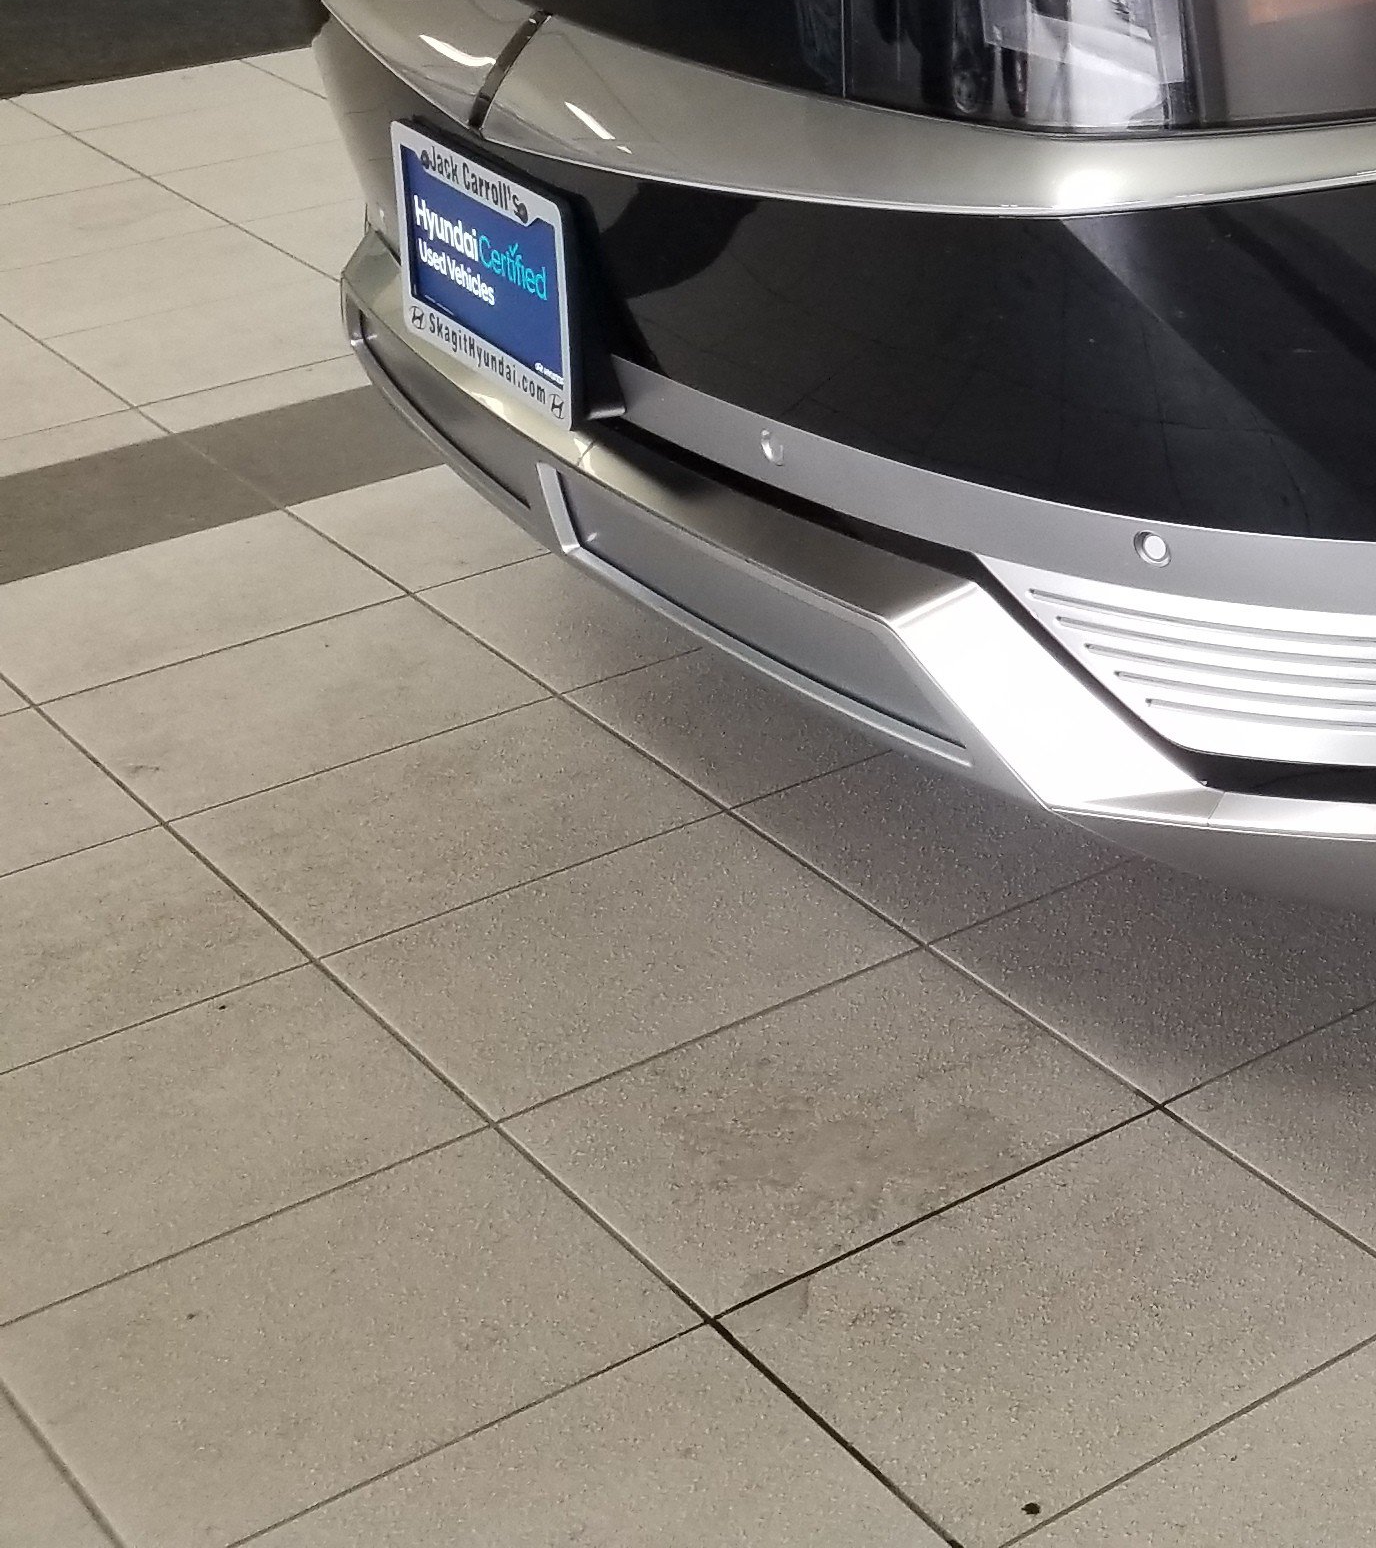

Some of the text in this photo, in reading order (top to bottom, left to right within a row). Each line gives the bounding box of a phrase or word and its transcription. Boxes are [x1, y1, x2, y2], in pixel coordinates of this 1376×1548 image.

[428, 146, 521, 216] Jack Carroll's
[414, 194, 547, 300] Hyundai Certified
[418, 238, 495, 305] Used Vehicles
[429, 313, 546, 404] SkagitHyundai.com
